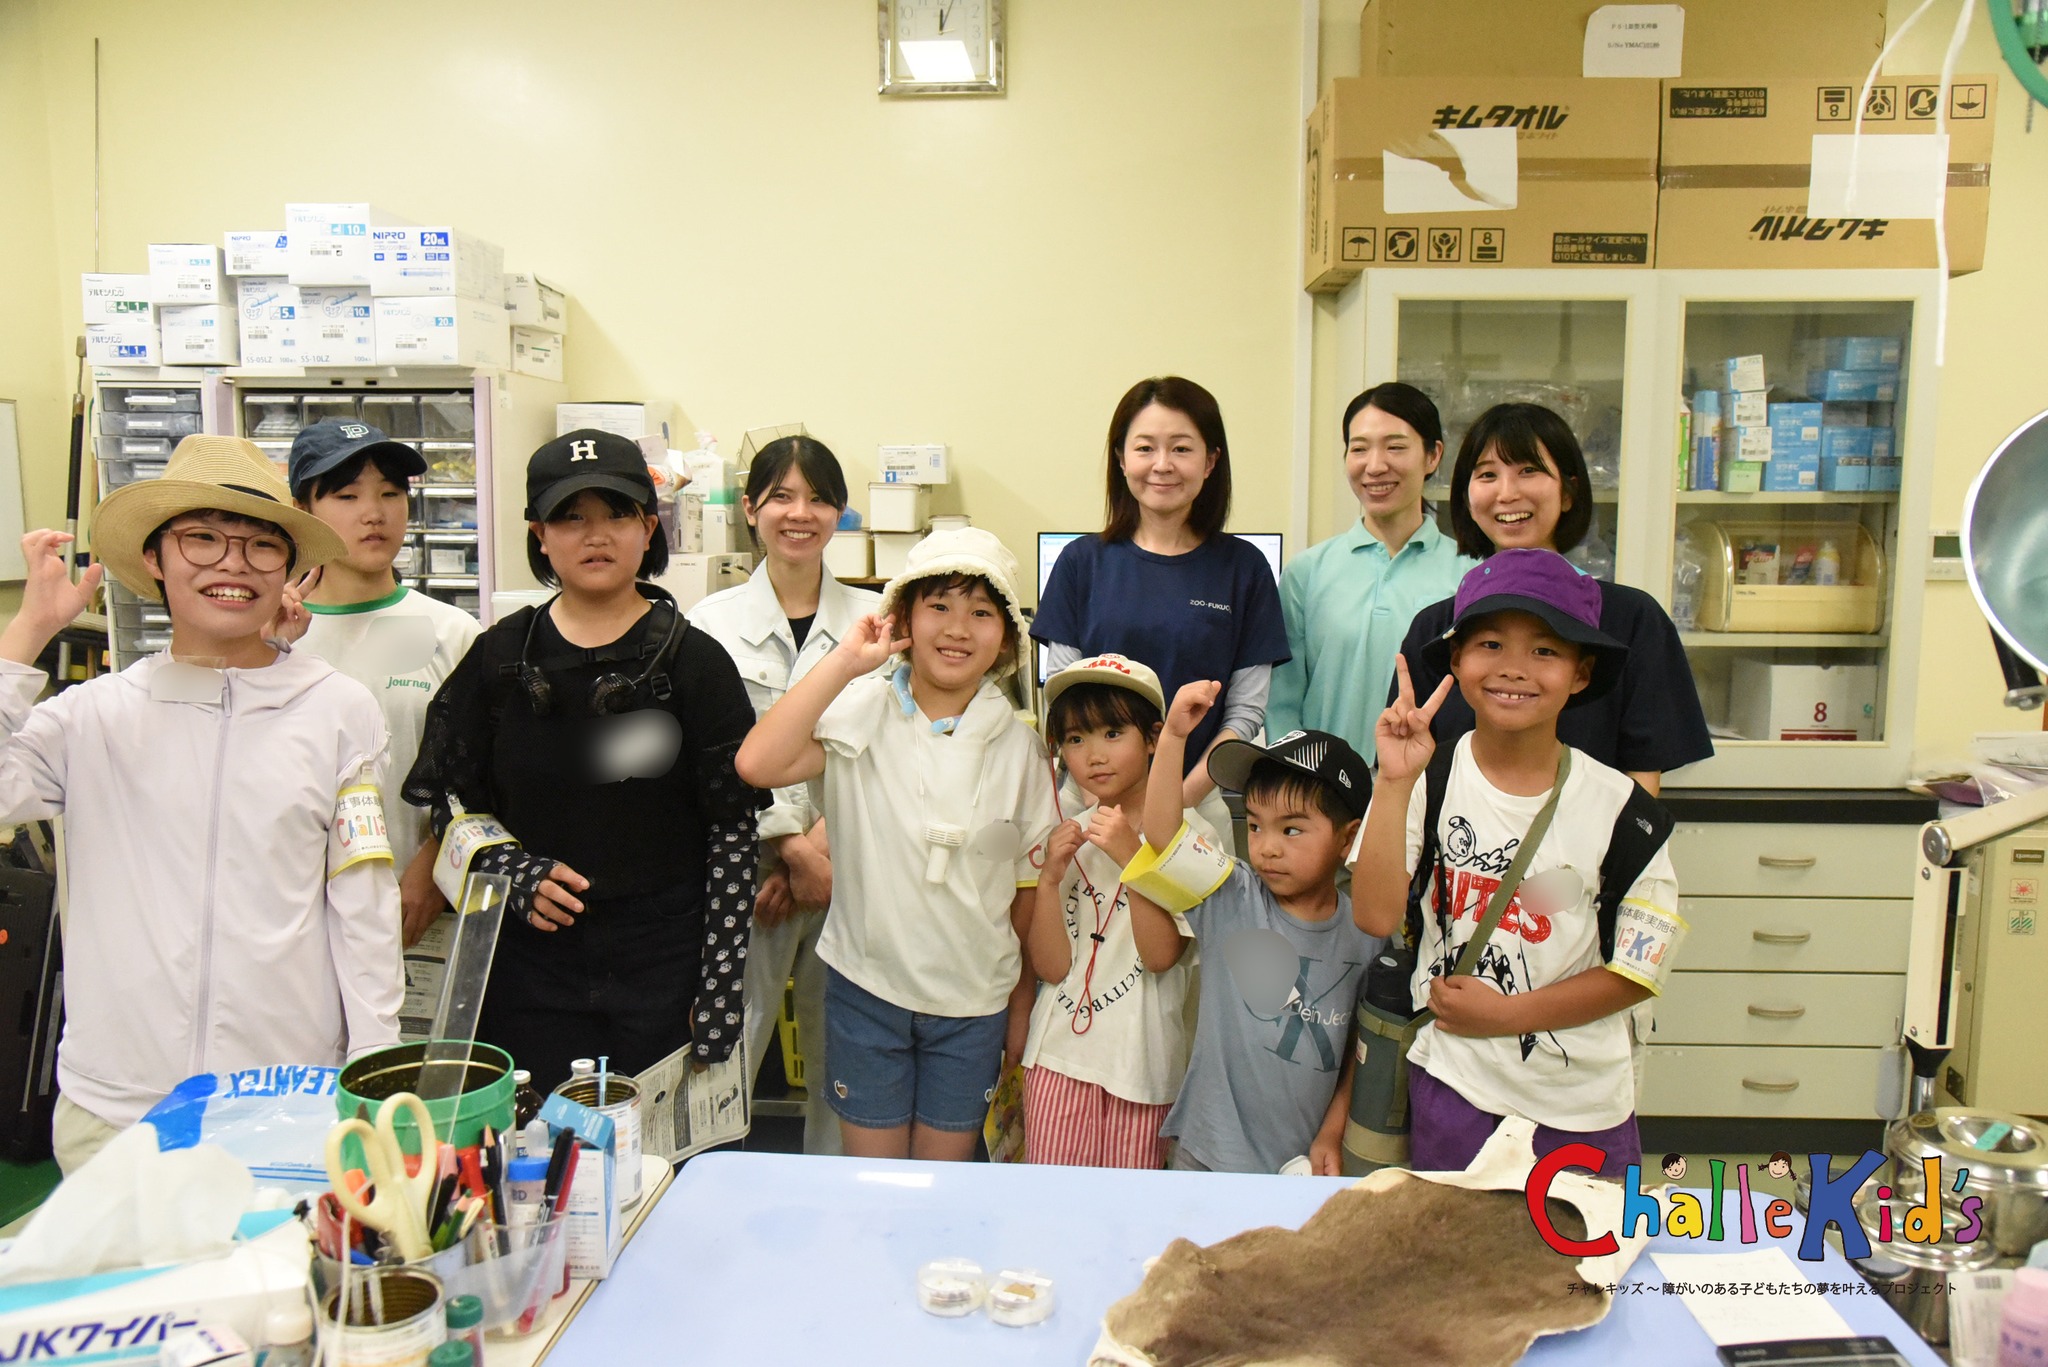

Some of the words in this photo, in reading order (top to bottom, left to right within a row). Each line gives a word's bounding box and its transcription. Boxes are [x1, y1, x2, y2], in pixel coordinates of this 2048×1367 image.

[972, 4, 979, 18] 2
[1432, 105, 1569, 129] キムタオル
[1829, 103, 1839, 117] 8
[373, 231, 406, 240] NIPRO
[1750, 215, 1890, 241] キムタオル
[1482, 232, 1493, 246] 8
[340, 424, 369, 438] P
[569, 439, 599, 462] H
[1813, 701, 1827, 723] 8
[0, 1311, 198, 1363] JKワイパー
